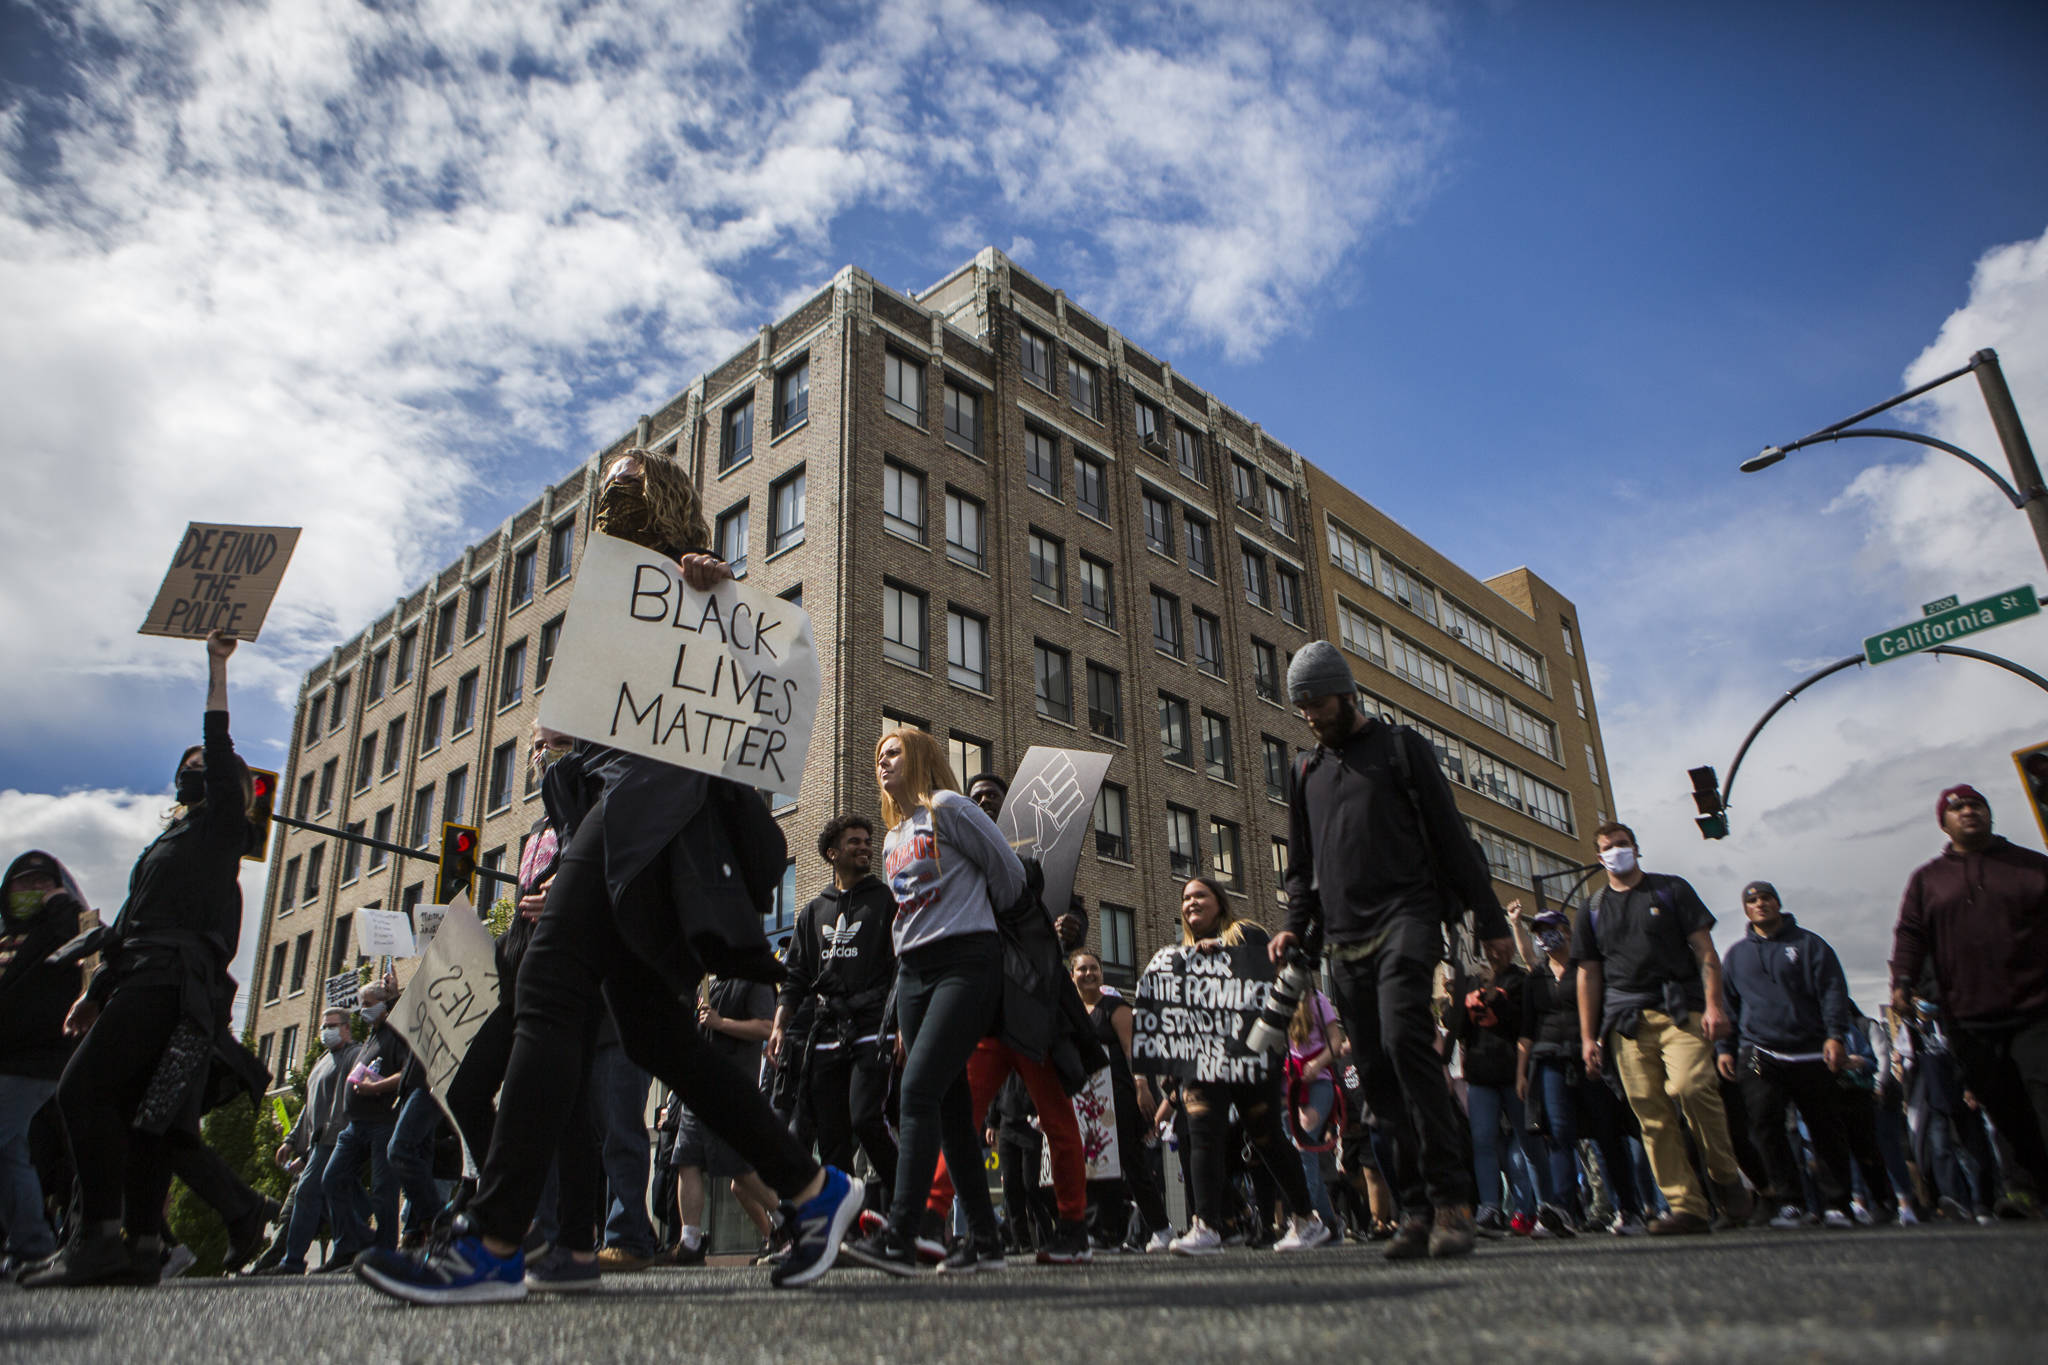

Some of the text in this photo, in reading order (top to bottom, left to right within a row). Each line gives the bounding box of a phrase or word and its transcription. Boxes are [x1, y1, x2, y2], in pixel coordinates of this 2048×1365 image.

[175, 527, 278, 575] DEFUND
[191, 573, 241, 603] THE
[163, 598, 247, 636] POLICE
[631, 564, 782, 659] BLACK
[1879, 595, 2020, 656] California St
[672, 643, 798, 725] LIVES
[610, 682, 786, 783] MATTER
[1180, 946, 1232, 979] YOUR
[1132, 1007, 1244, 1040] TO STAND UP
[1132, 1033, 1170, 1060] FOR
[1196, 1049, 1269, 1085] RIGHT!
